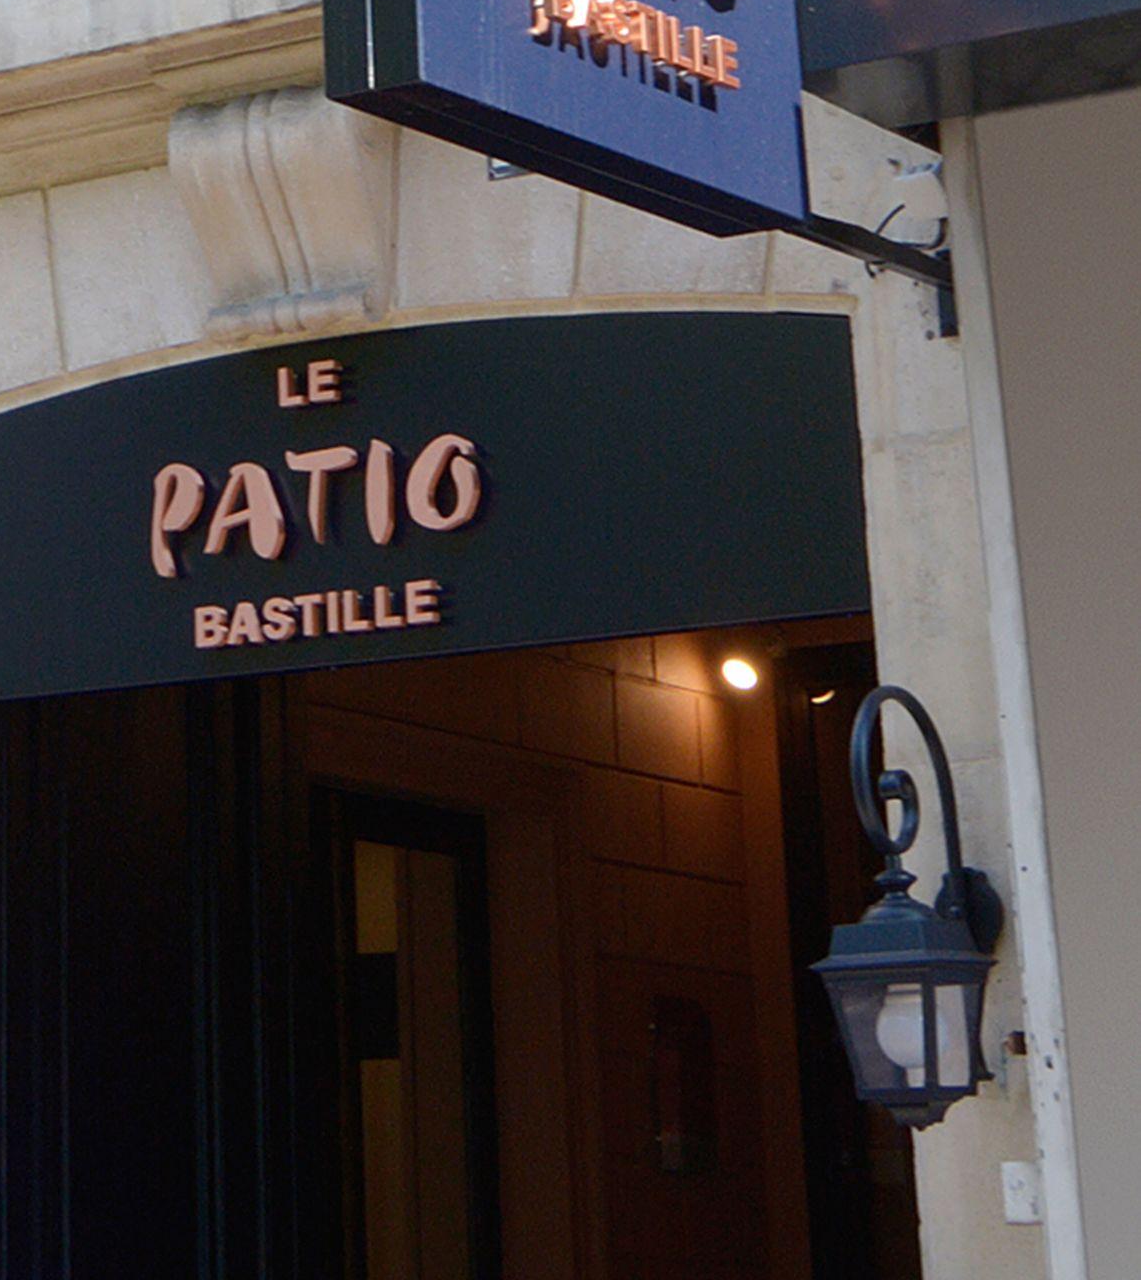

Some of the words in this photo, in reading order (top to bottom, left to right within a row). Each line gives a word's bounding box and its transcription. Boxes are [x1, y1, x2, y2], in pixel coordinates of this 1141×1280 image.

[276, 358, 342, 408] LE
[150, 433, 482, 579] PATIO
[194, 578, 442, 649] BASTILLE
